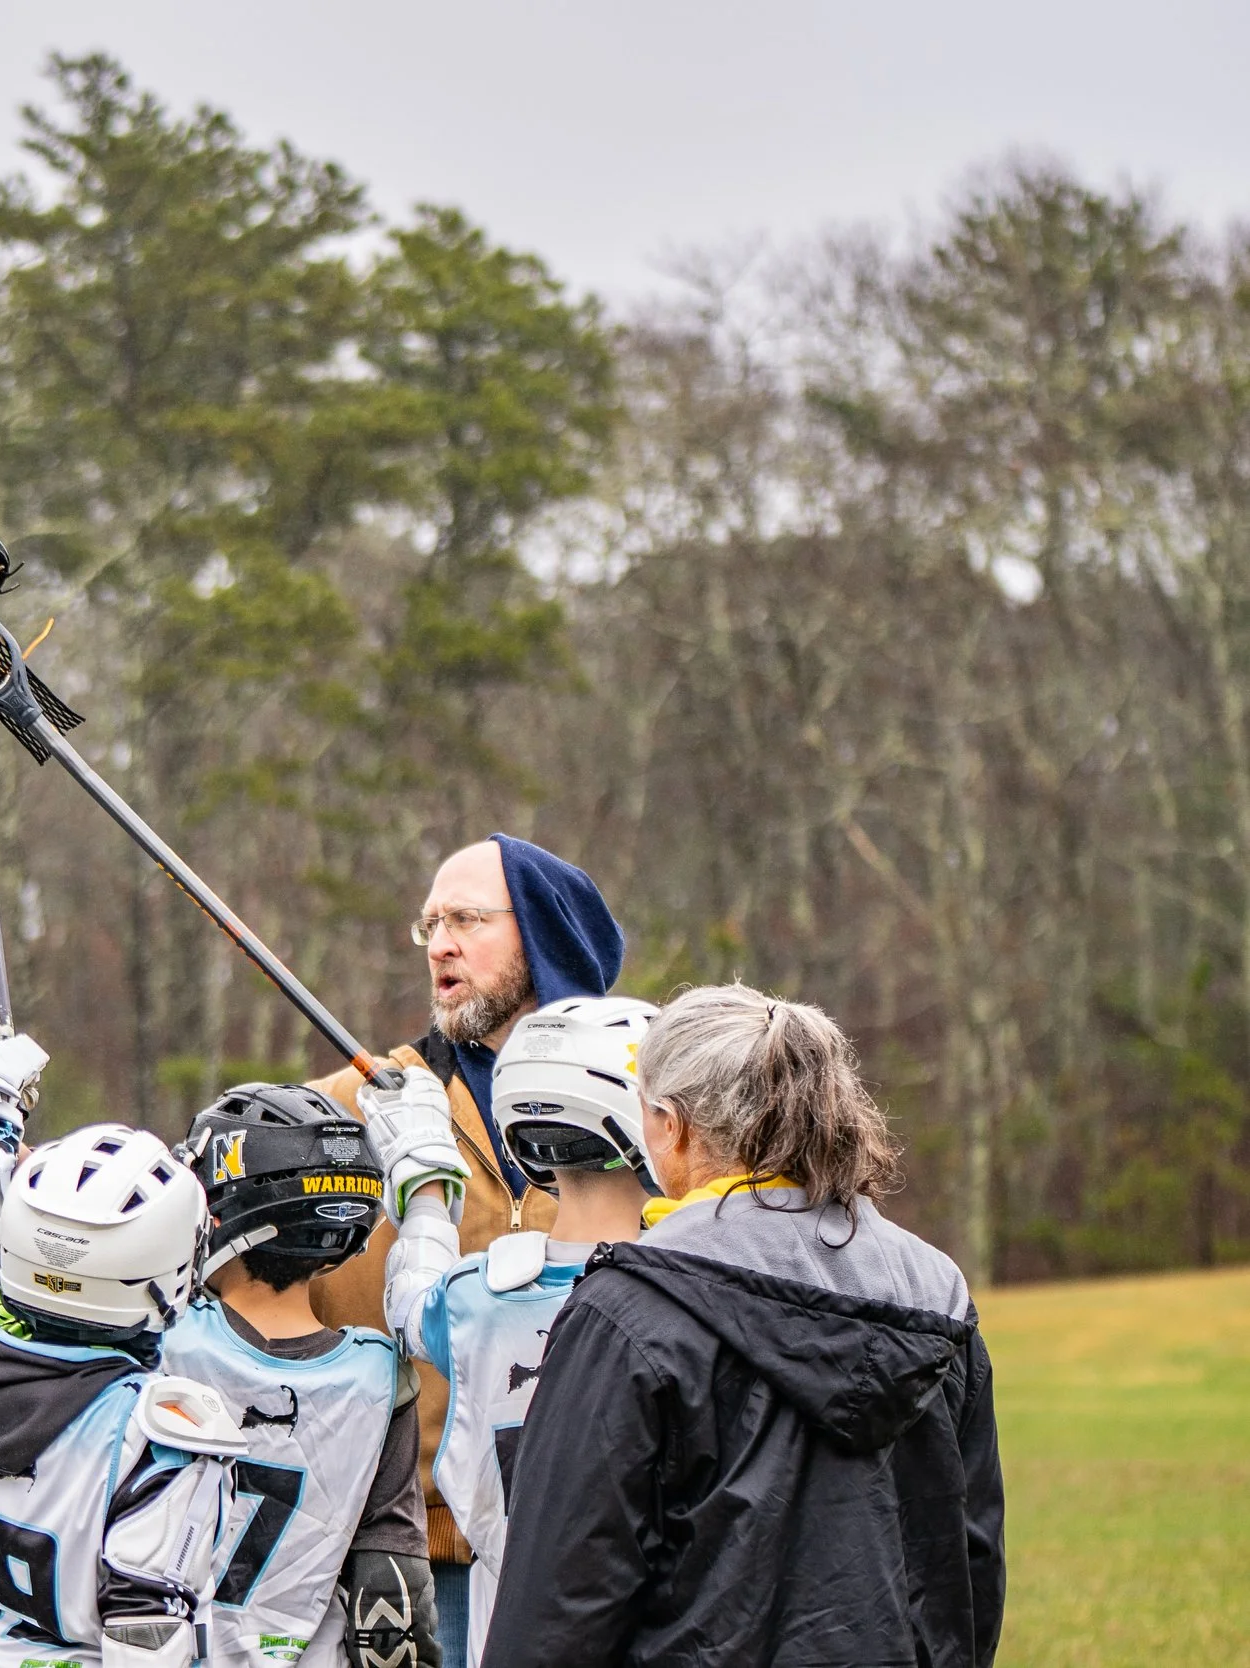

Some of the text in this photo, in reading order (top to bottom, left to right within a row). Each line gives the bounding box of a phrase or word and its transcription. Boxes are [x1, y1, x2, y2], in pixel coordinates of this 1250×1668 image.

[213, 1128, 249, 1186] N
[302, 1174, 383, 1199] WARRIORS
[36, 1227, 91, 1246] cascade
[353, 1622, 419, 1650] STX
